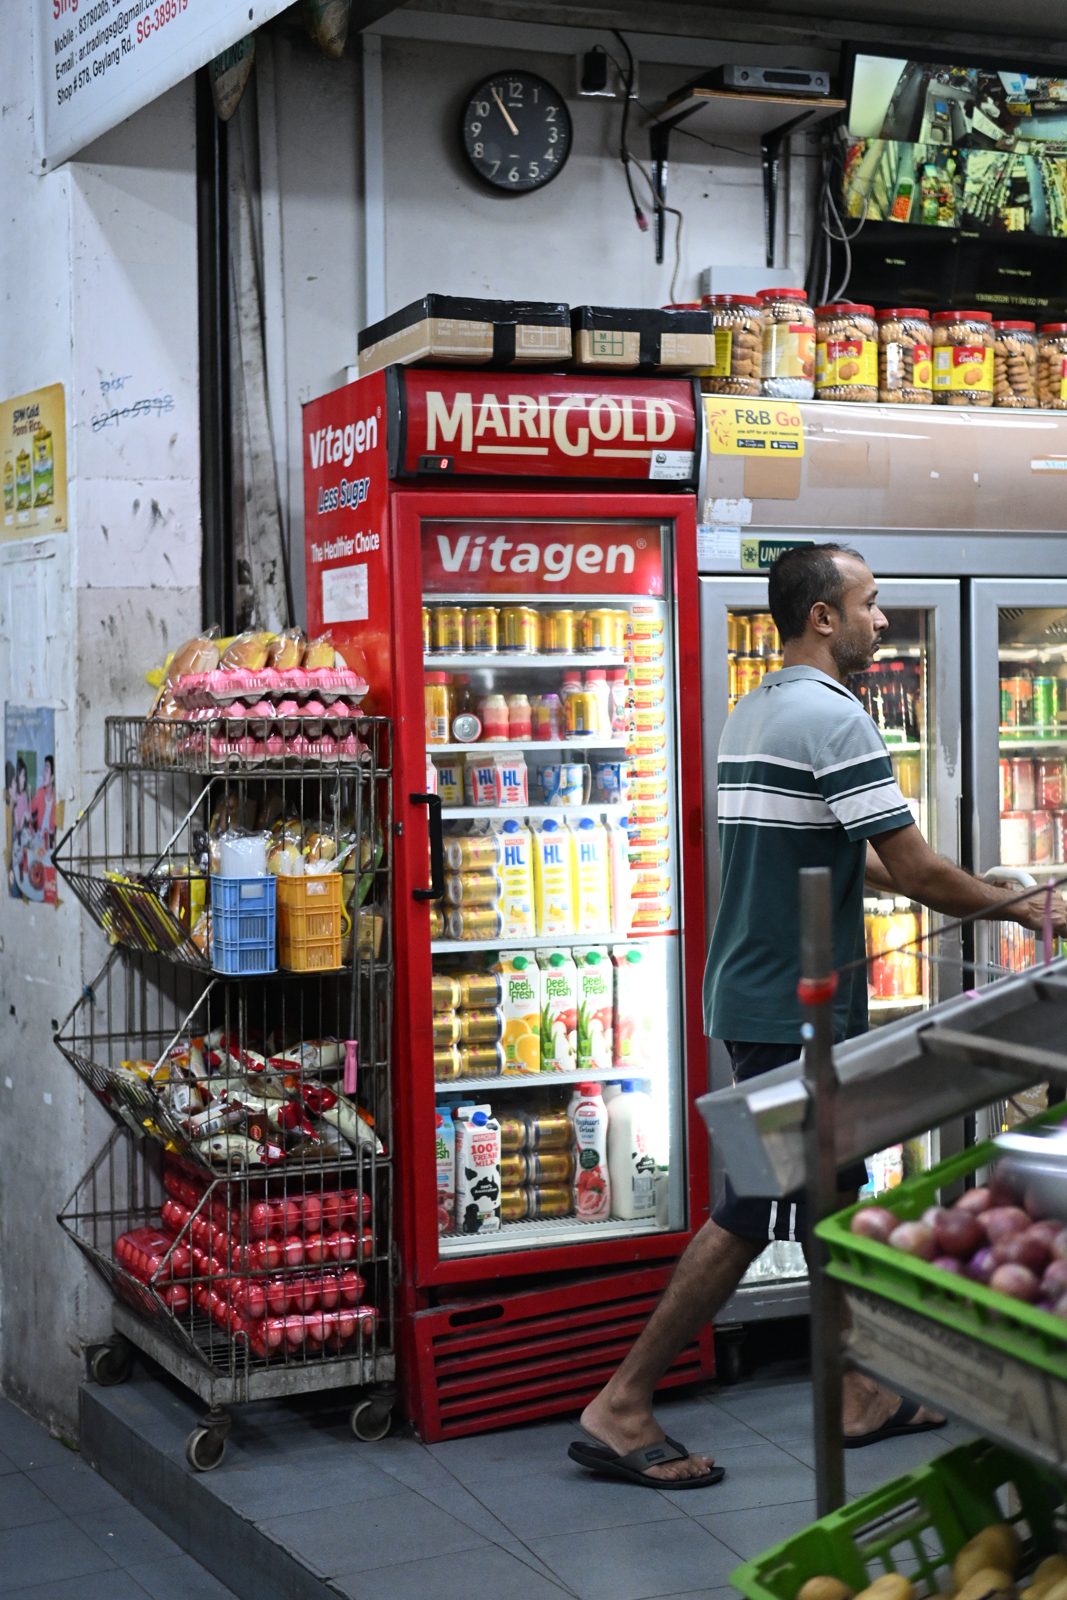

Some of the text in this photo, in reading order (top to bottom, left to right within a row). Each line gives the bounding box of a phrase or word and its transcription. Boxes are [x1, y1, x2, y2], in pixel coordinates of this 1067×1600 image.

[55, 28, 74, 56] Mobile
[56, 51, 74, 80] E-mail
[57, 84, 73, 105] Shop
[92, 47, 120, 77] Geylang
[508, 82, 523, 98] 12
[533, 89, 538, 103] 1
[476, 101, 490, 117] 10
[545, 106, 556, 122] 2
[471, 122, 482, 137] 9
[548, 127, 558, 143] 3
[473, 142, 484, 158] 8
[543, 147, 554, 161] 4
[490, 160, 501, 178] 7
[508, 166, 519, 182] 6
[529, 161, 539, 177] 5
[599, 332, 607, 341] M
[600, 344, 606, 353] S
[425, 391, 677, 456] MARIGOLD
[735, 409, 801, 427] F&B Go
[309, 415, 378, 470] Vitagen
[440, 458, 449, 469] 8
[318, 476, 370, 515] Less Sugar
[310, 529, 380, 563] The Healthier Choice
[436, 535, 636, 582] Vitagen
[440, 769, 457, 786] HL
[503, 770, 521, 787] HL
[505, 846, 525, 866] HL
[544, 845, 563, 865] HL
[580, 843, 599, 862] HL
[511, 988, 535, 1004] Fresh
[548, 985, 571, 1001] Fresh
[473, 1152, 498, 1162] FRESH
[475, 1160, 495, 1168] MILK
